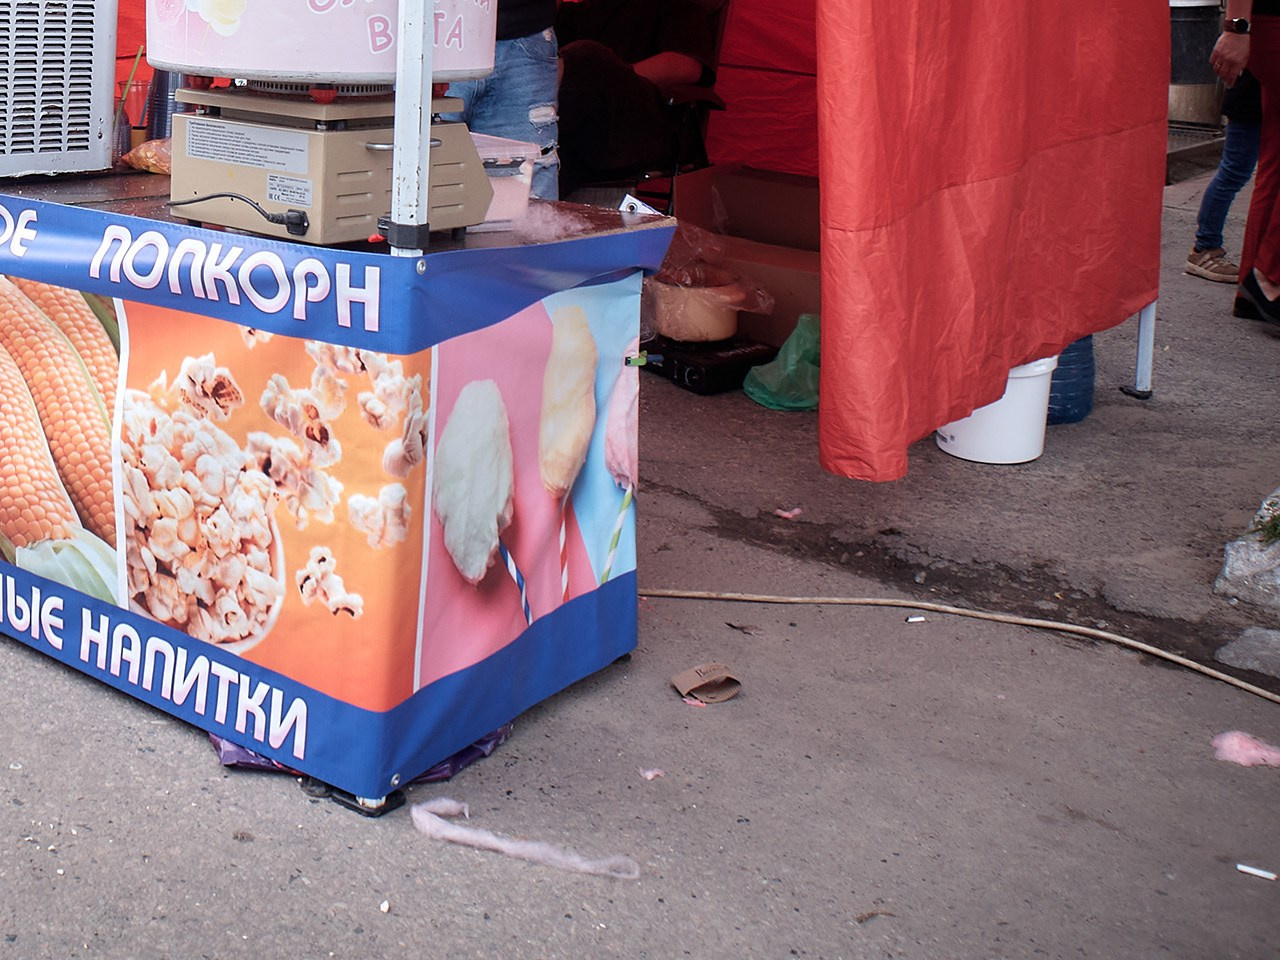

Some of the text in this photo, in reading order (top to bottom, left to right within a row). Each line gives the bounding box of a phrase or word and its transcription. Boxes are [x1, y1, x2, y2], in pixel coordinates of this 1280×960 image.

[367, 12, 465, 54] ВТА
[89, 224, 380, 332] ПОПКОРН
[79, 608, 308, 760] НАПИТКИ
